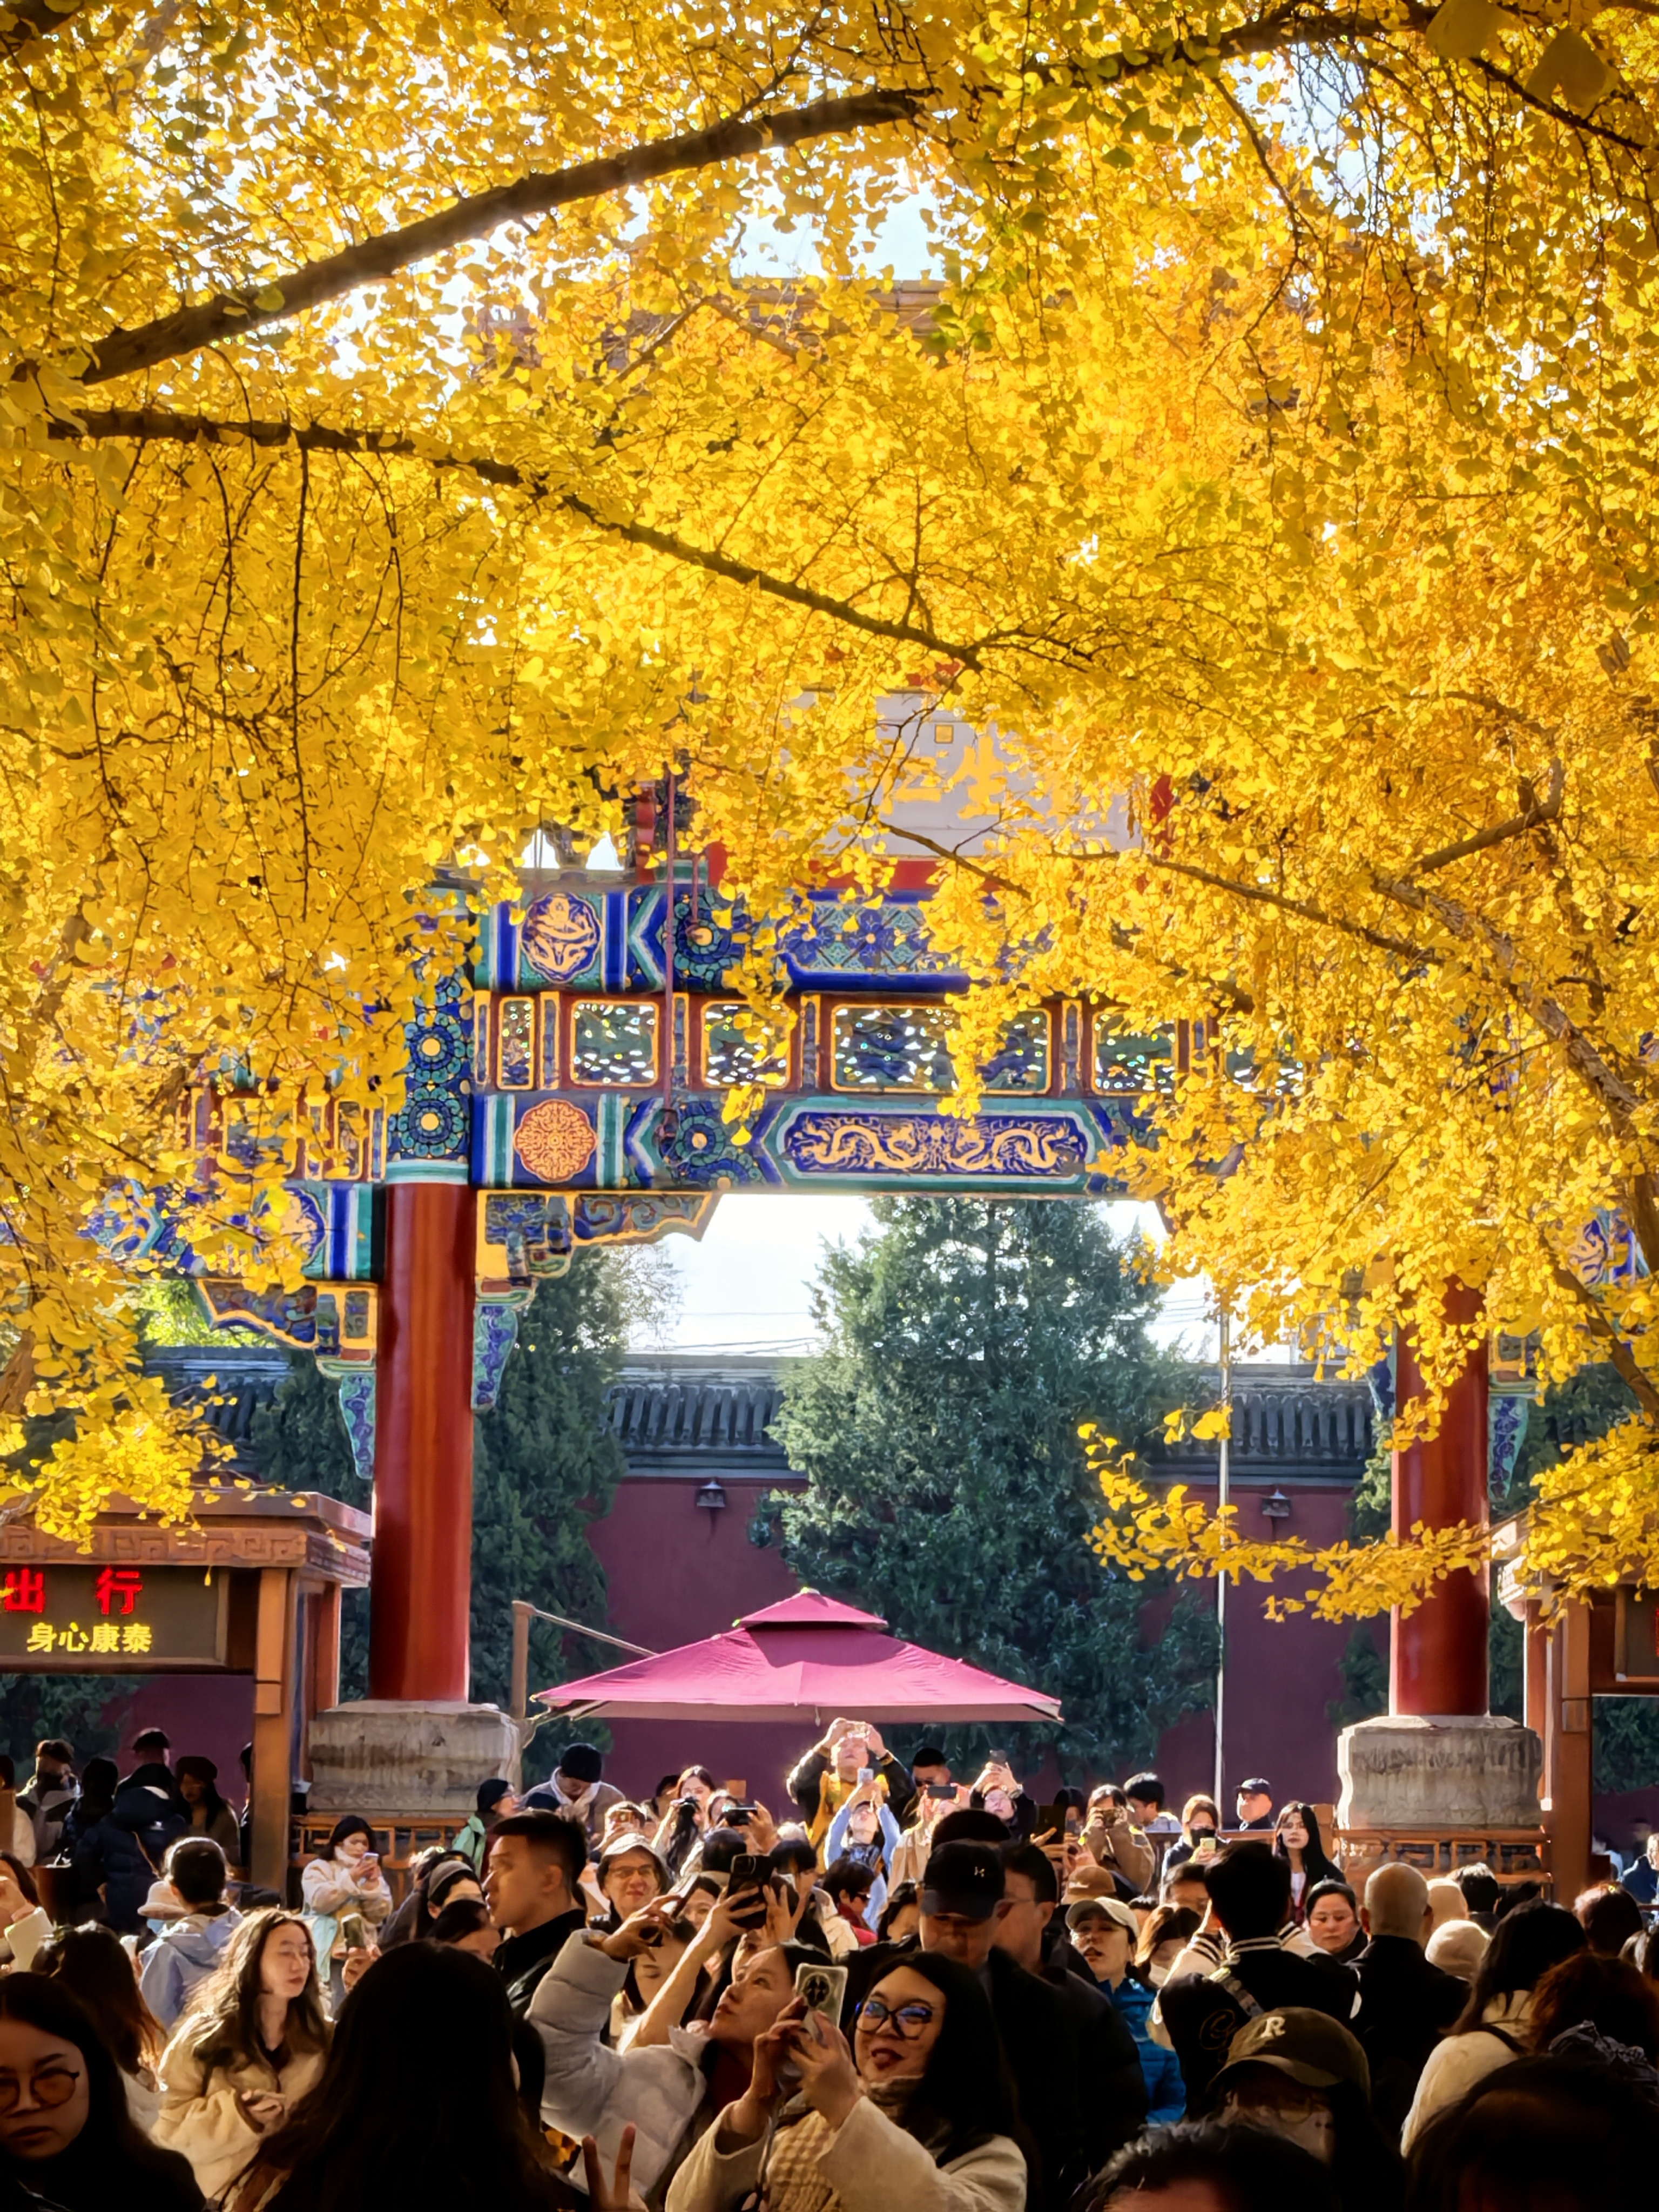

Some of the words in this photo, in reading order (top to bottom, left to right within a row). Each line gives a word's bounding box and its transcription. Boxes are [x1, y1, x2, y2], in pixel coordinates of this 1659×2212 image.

[26, 1622, 152, 1653] 身心康泰
[1257, 2016, 1286, 2039] R
